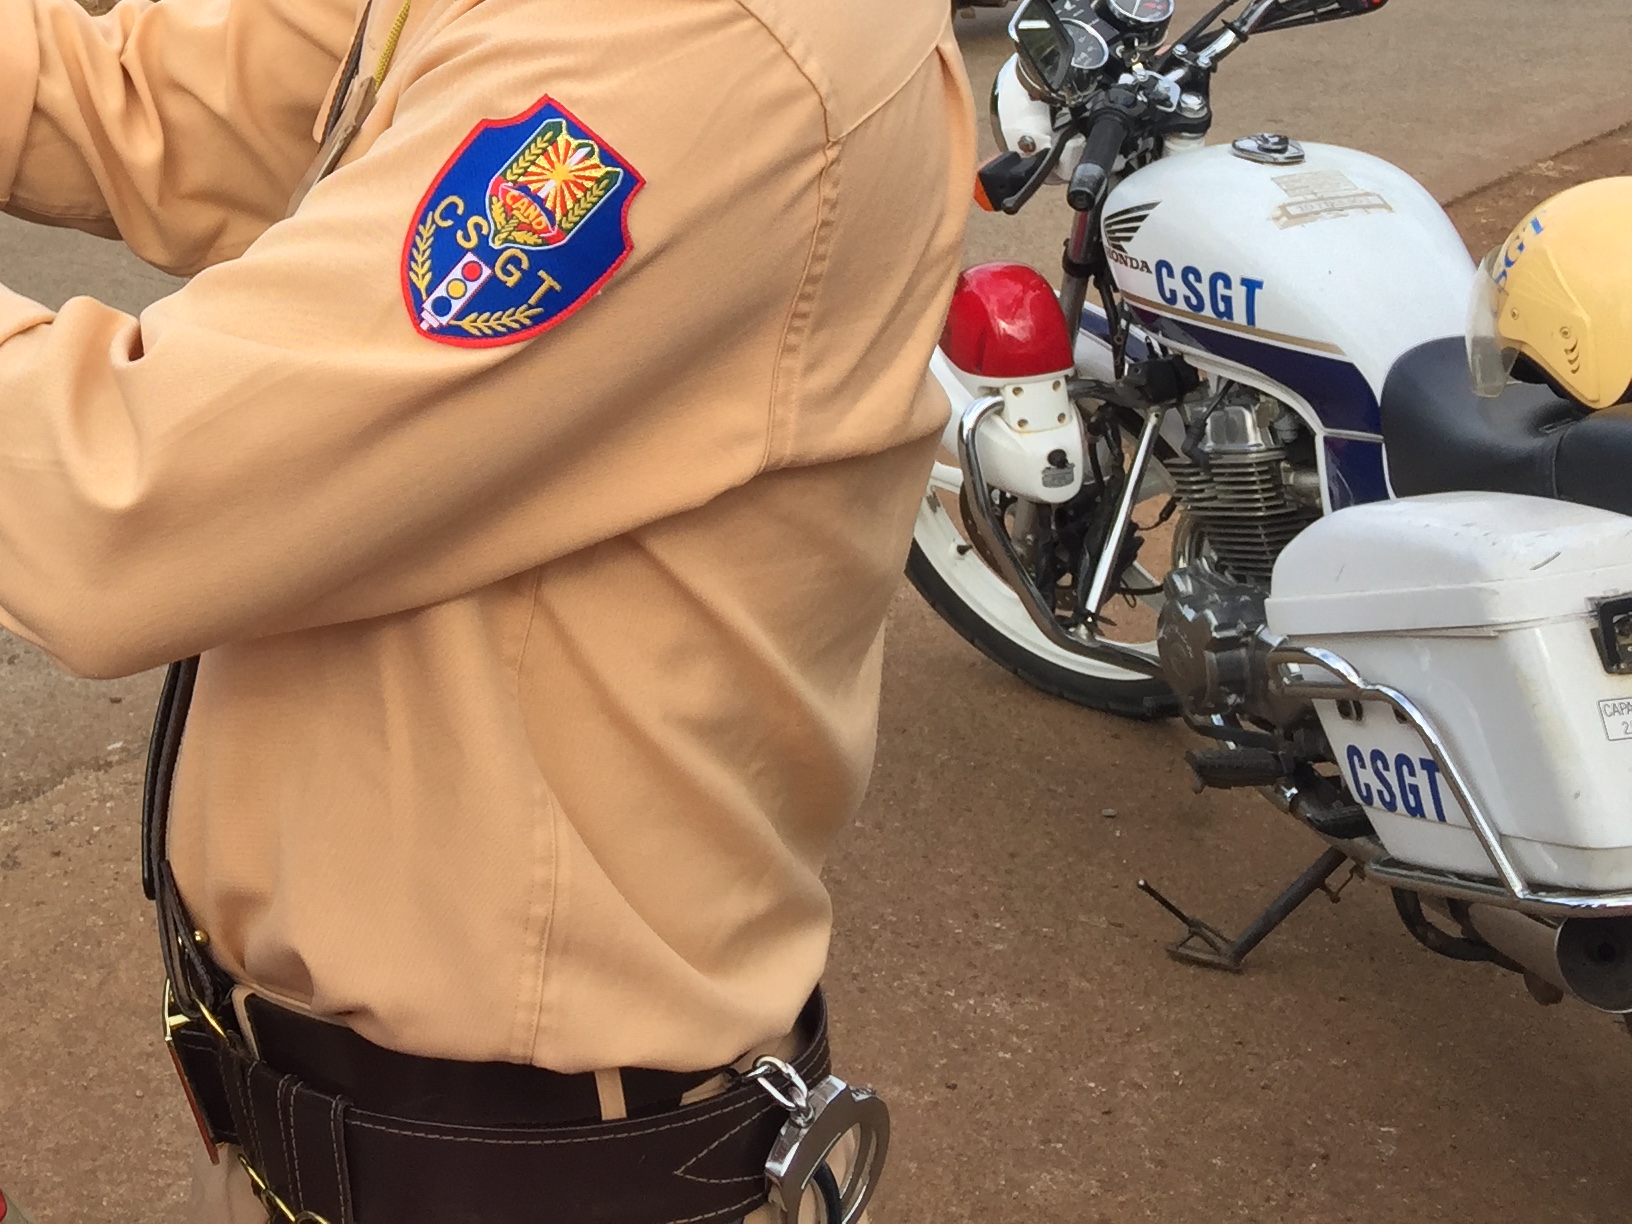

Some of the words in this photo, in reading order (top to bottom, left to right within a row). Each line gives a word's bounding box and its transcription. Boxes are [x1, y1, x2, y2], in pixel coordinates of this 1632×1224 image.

[505, 190, 547, 231] CAND
[433, 194, 562, 307] CSGT
[1154, 258, 1265, 328] CSGT
[1346, 743, 1447, 823] CSGT
